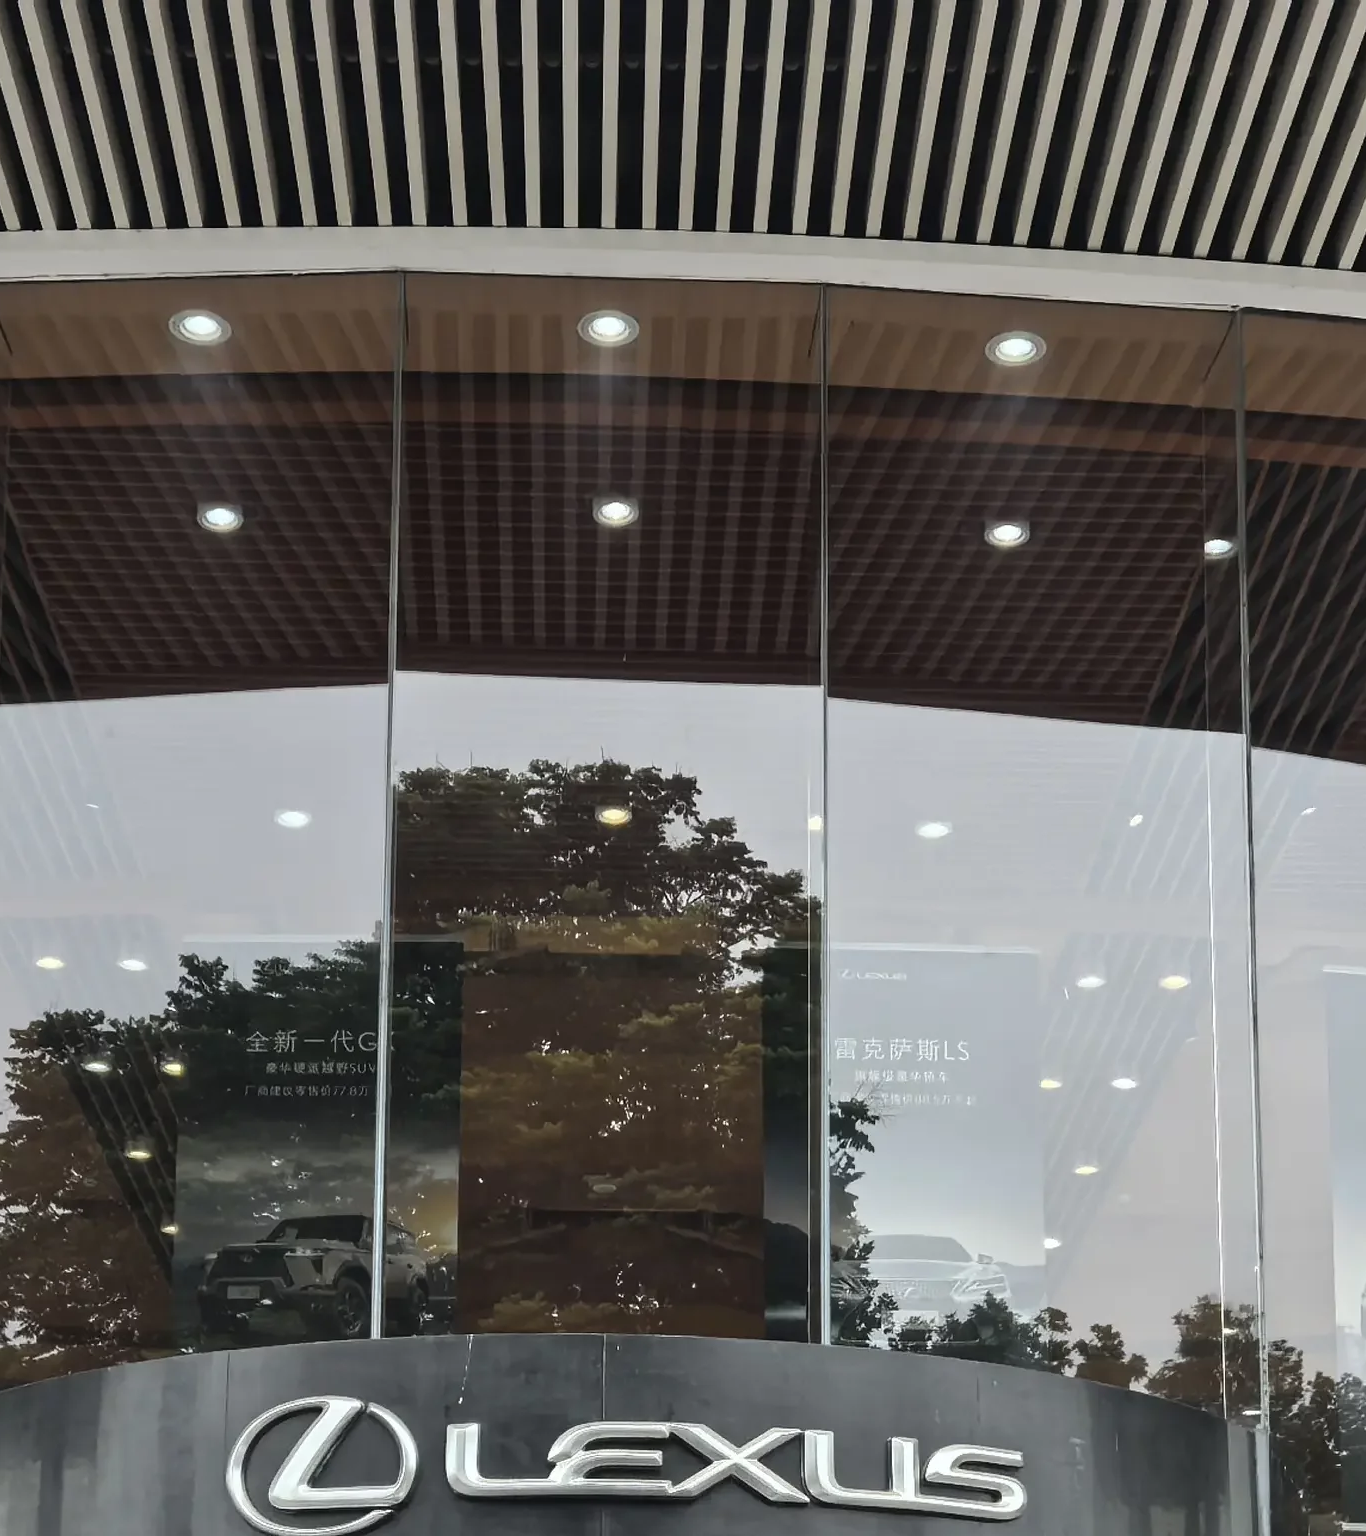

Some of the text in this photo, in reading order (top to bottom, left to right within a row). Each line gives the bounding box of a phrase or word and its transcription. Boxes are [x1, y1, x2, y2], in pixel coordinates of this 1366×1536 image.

[245, 1029, 396, 1054] 全新一代G
[834, 1036, 971, 1062] 雷克萨斯LS
[444, 1420, 1029, 1523] LEXUS
